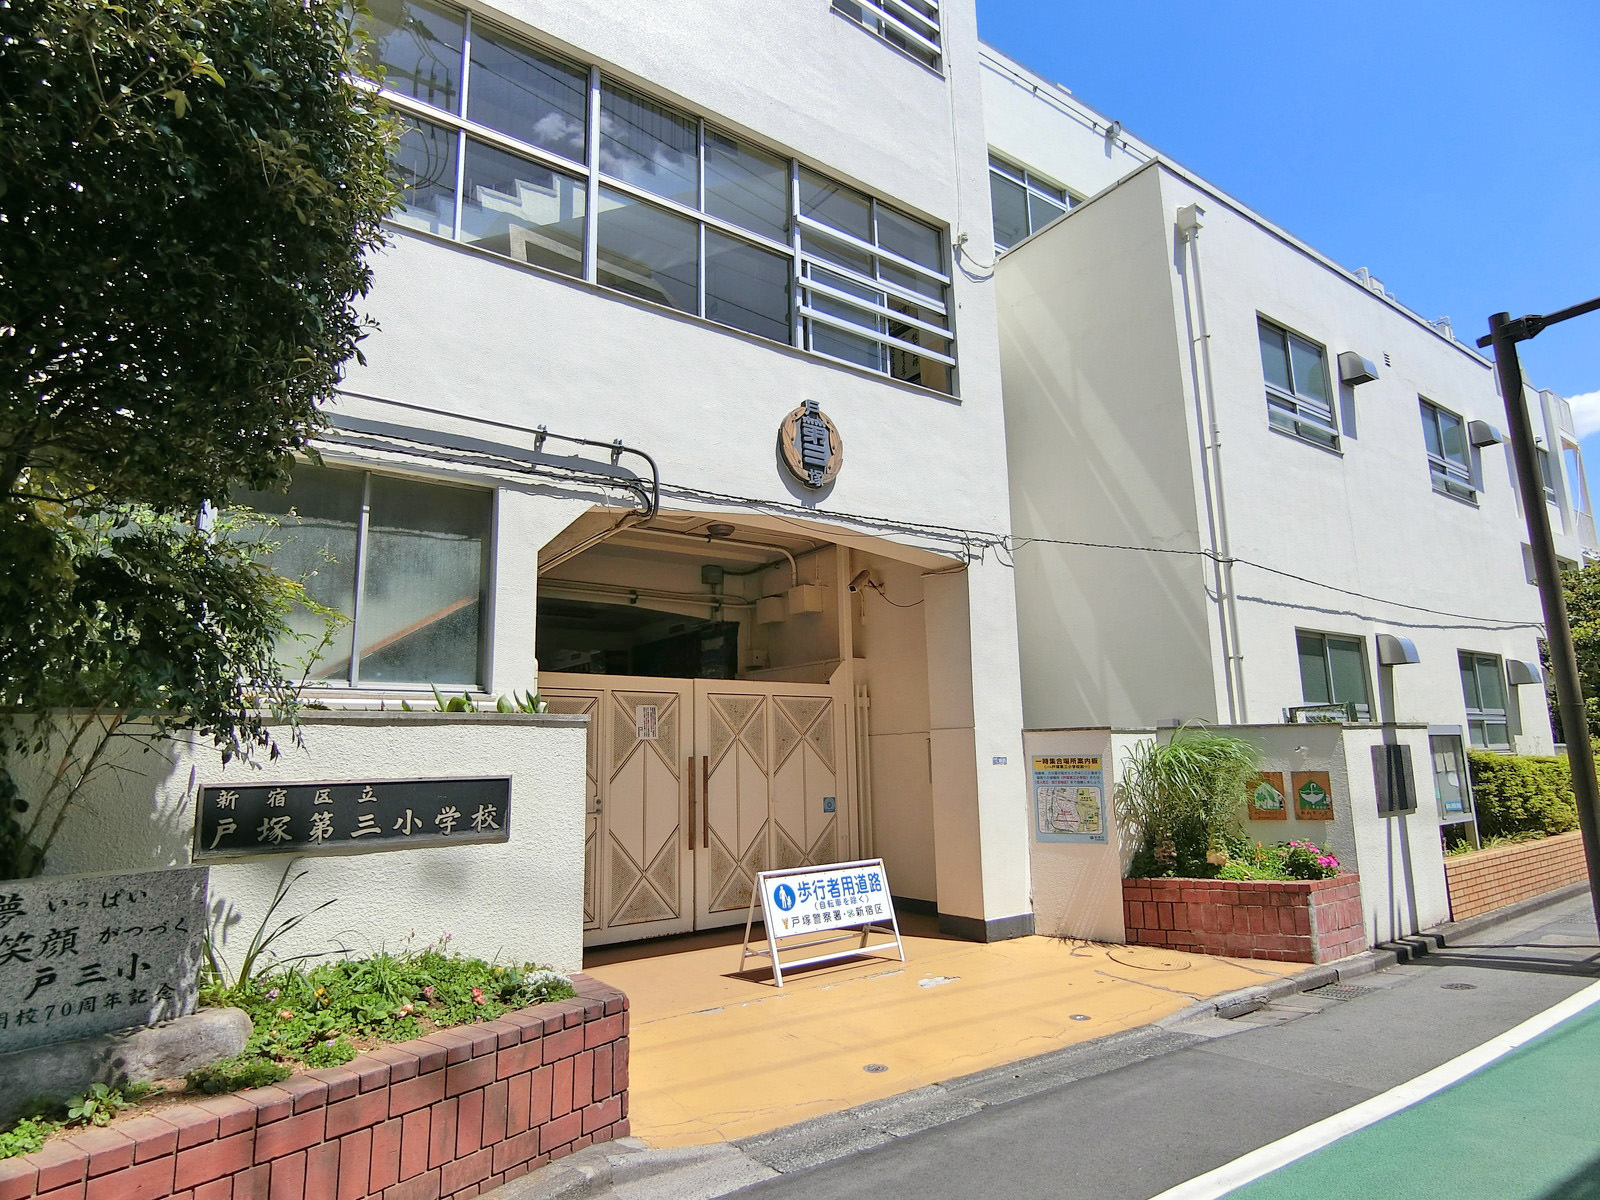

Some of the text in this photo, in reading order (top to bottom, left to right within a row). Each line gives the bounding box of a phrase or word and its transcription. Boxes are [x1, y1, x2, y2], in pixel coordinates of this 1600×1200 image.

[216, 785, 378, 810] 新宿区立
[209, 803, 501, 851] 戸塚第三小学校
[48, 888, 148, 913] いっぱい
[797, 871, 882, 904] 歩行者用道路
[0, 917, 189, 966] 笑顔 がつづく
[25, 952, 152, 1001] 戸三小
